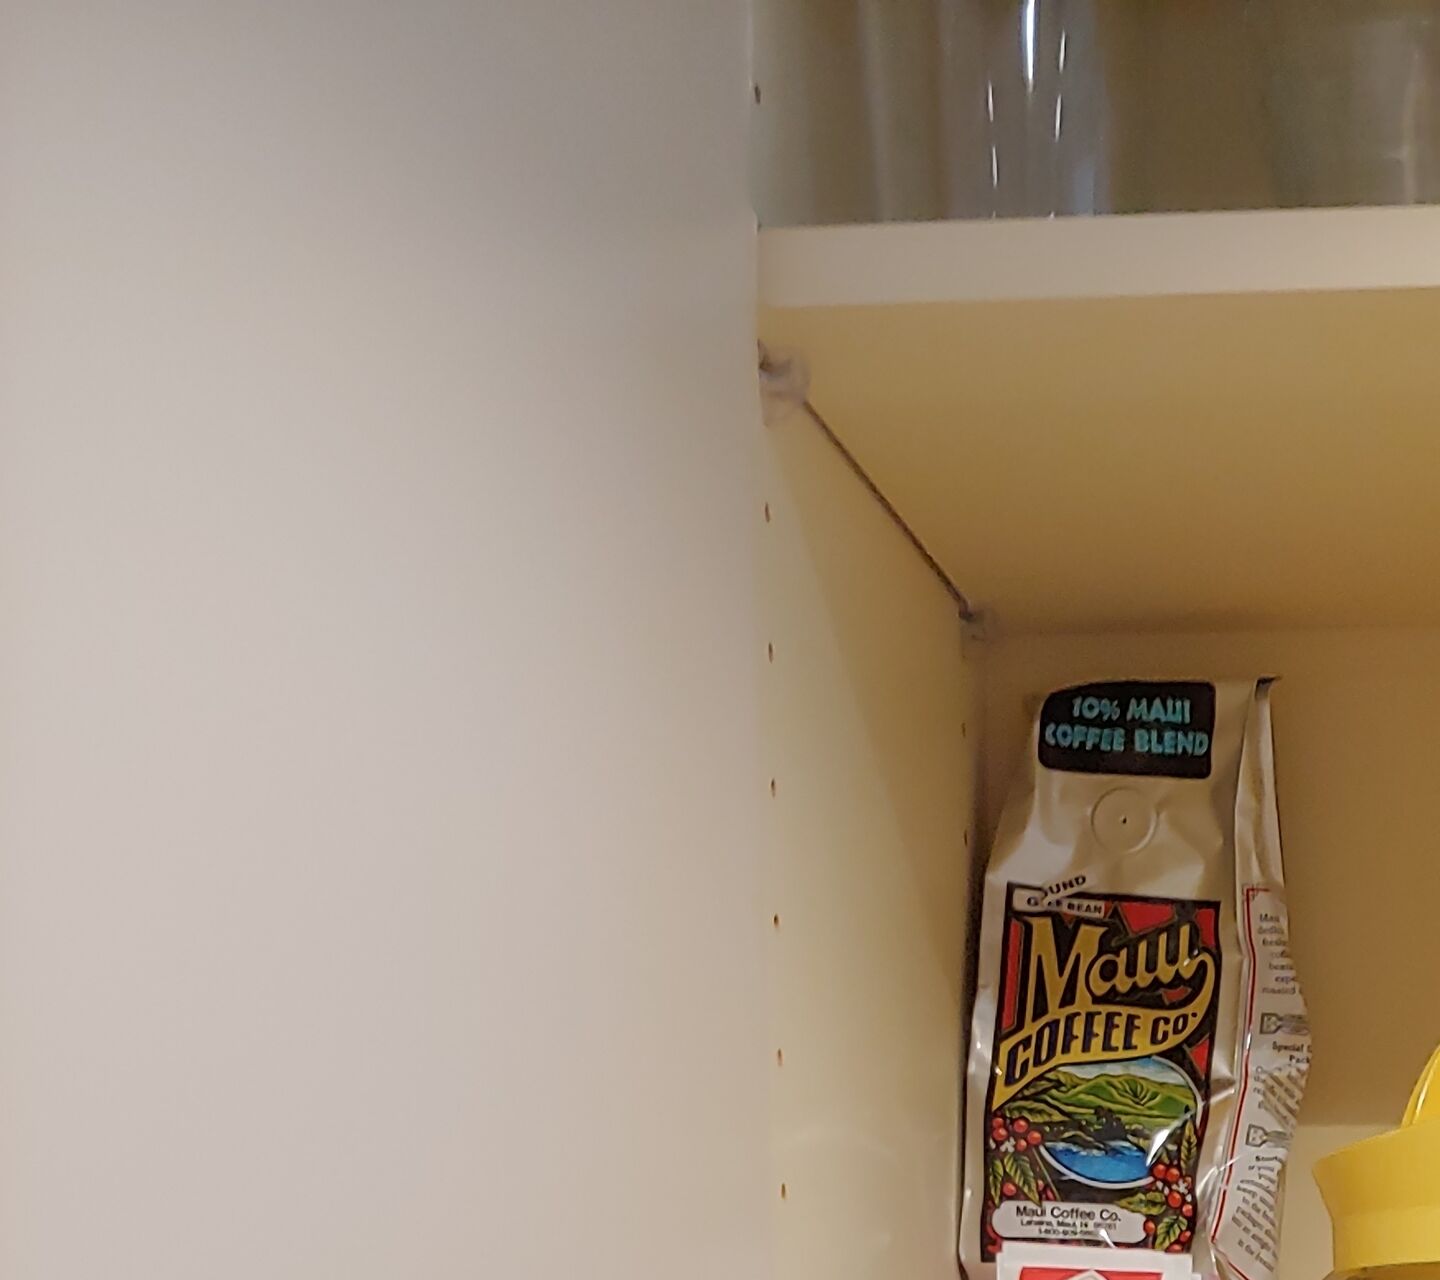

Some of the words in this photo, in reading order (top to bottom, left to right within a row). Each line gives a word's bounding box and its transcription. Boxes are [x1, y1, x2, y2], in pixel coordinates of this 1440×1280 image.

[1072, 696, 1120, 720] 10%
[1126, 697, 1191, 724] MAUI
[1044, 722, 1125, 752] COFFEE
[1134, 730, 1210, 756] BLEND
[1024, 915, 1202, 1018] Maui
[1004, 1011, 1142, 1087] COFFEE
[1015, 1205, 1046, 1217] Maui
[1051, 1206, 1096, 1221] Coffee
[1100, 1208, 1121, 1222] Co.
